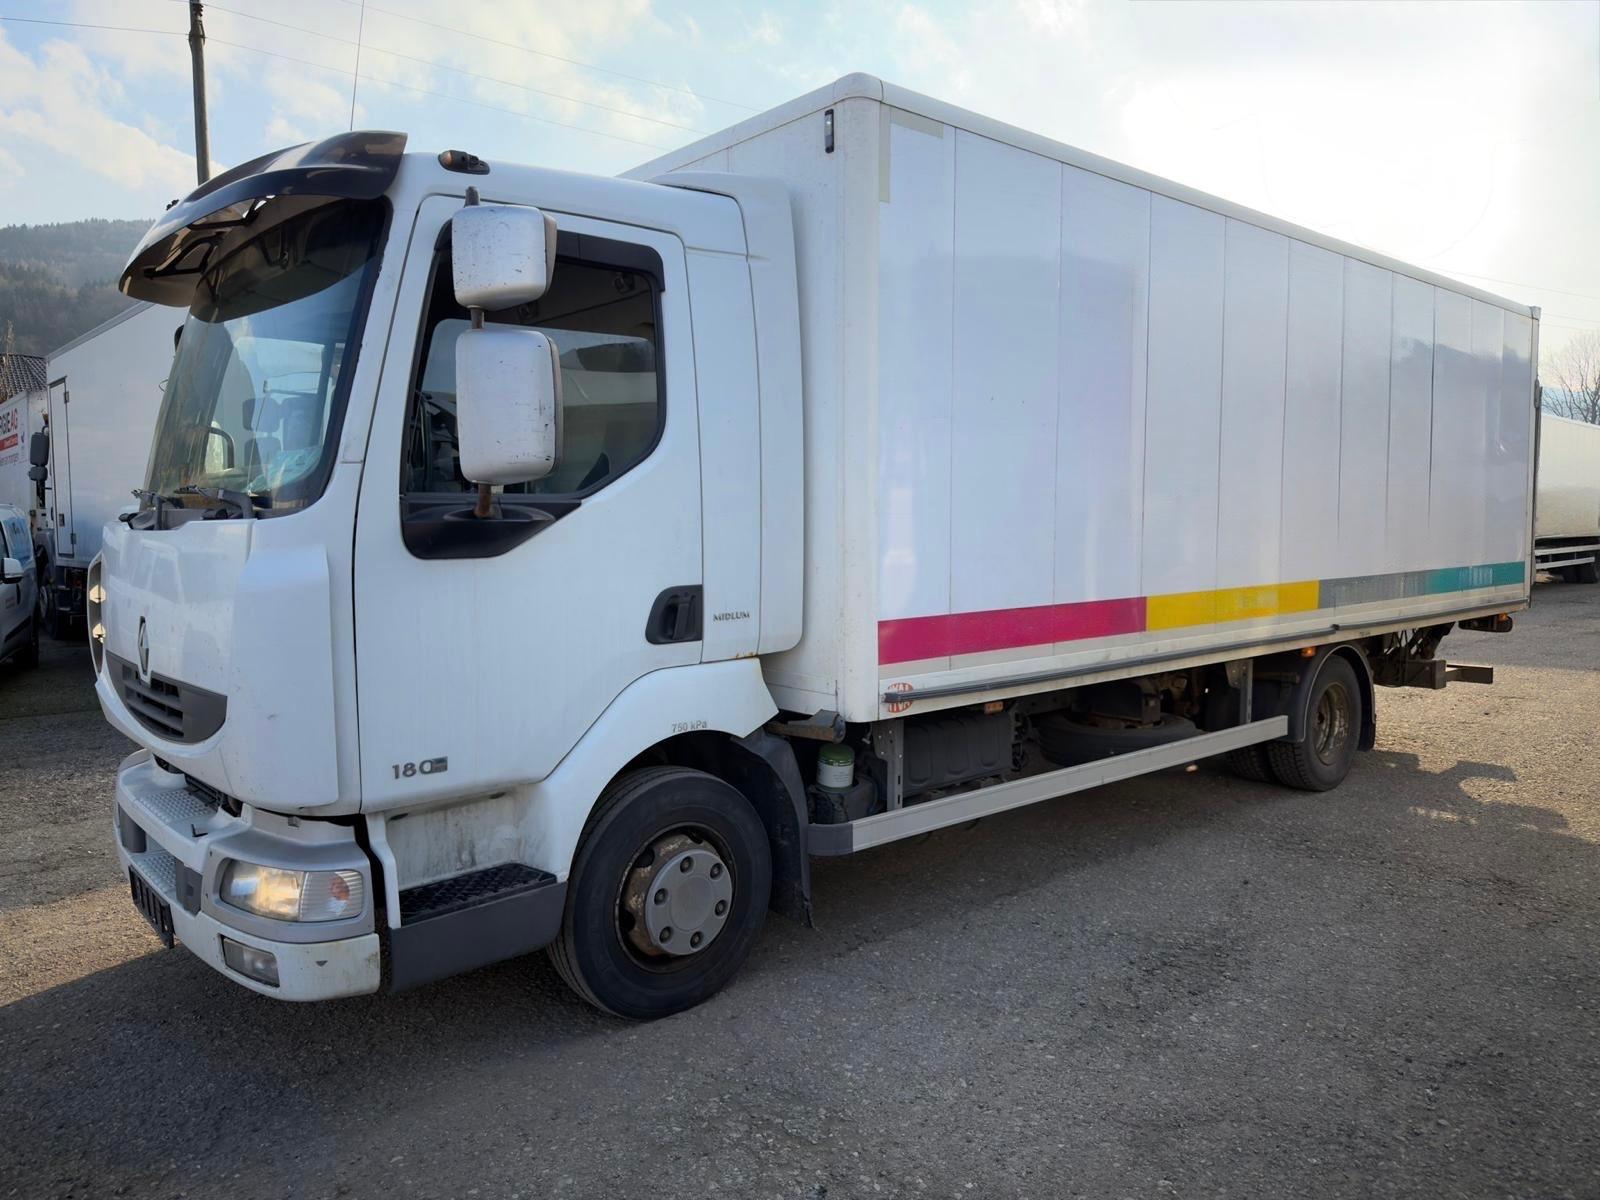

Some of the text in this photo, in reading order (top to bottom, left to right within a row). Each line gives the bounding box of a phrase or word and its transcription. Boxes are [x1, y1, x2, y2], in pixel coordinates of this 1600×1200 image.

[713, 611, 750, 622] MIDLUM
[672, 719, 708, 734] 750 kPa
[392, 759, 434, 779] 180
